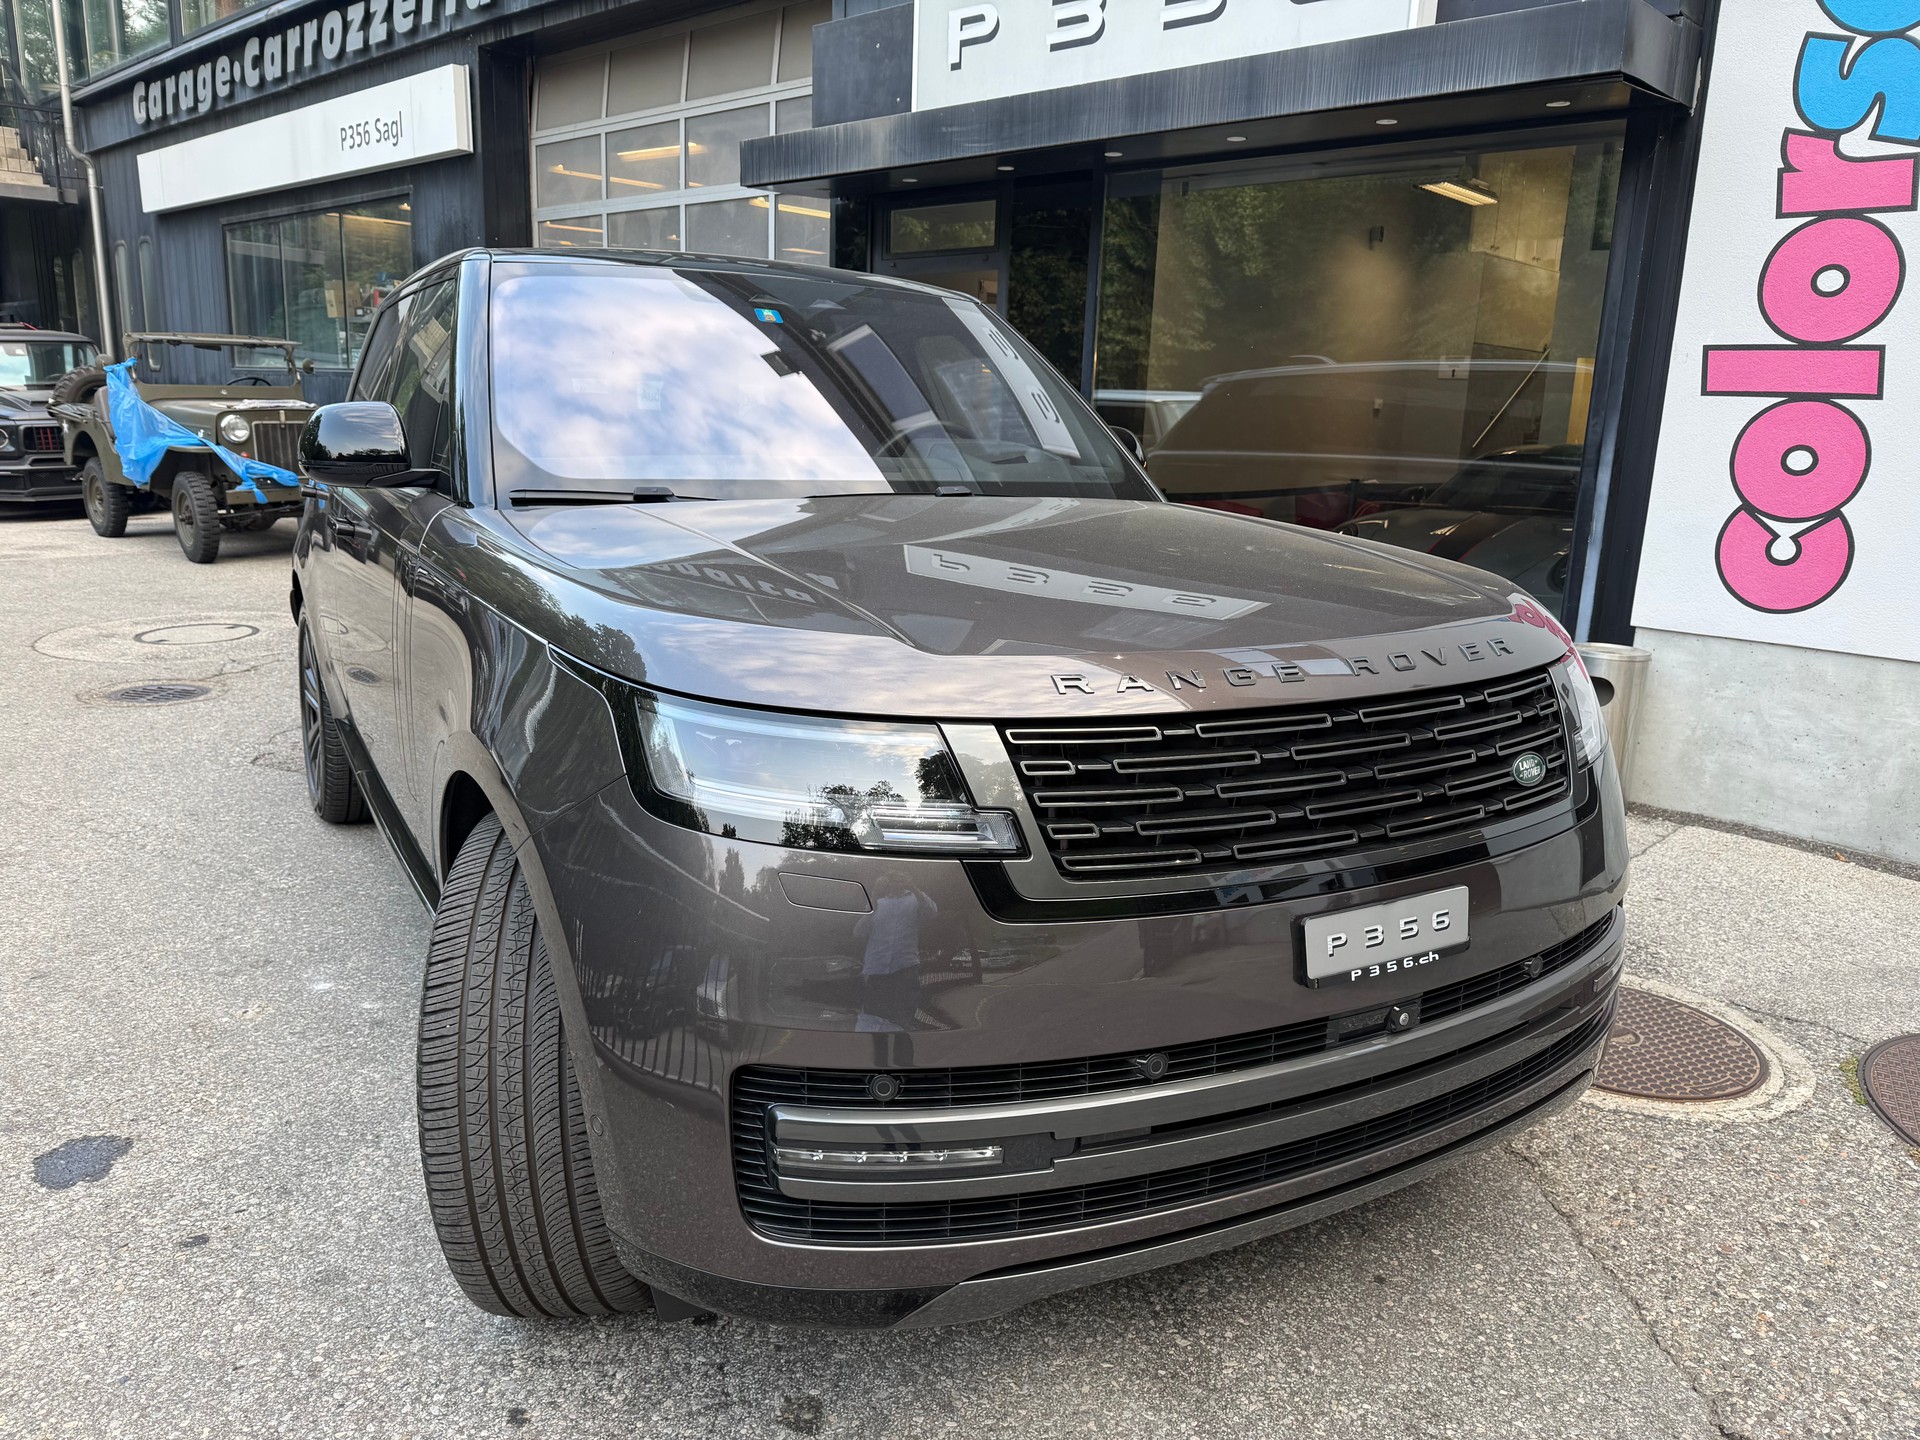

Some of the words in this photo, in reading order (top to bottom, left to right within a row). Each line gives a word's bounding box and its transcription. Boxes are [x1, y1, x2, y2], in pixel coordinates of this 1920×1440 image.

[340, 121, 370, 151] P356
[374, 110, 403, 147] Sagl
[1050, 663, 1306, 695] RANGE
[1345, 637, 1514, 676] ROVER
[1523, 765, 1541, 779] ROVER
